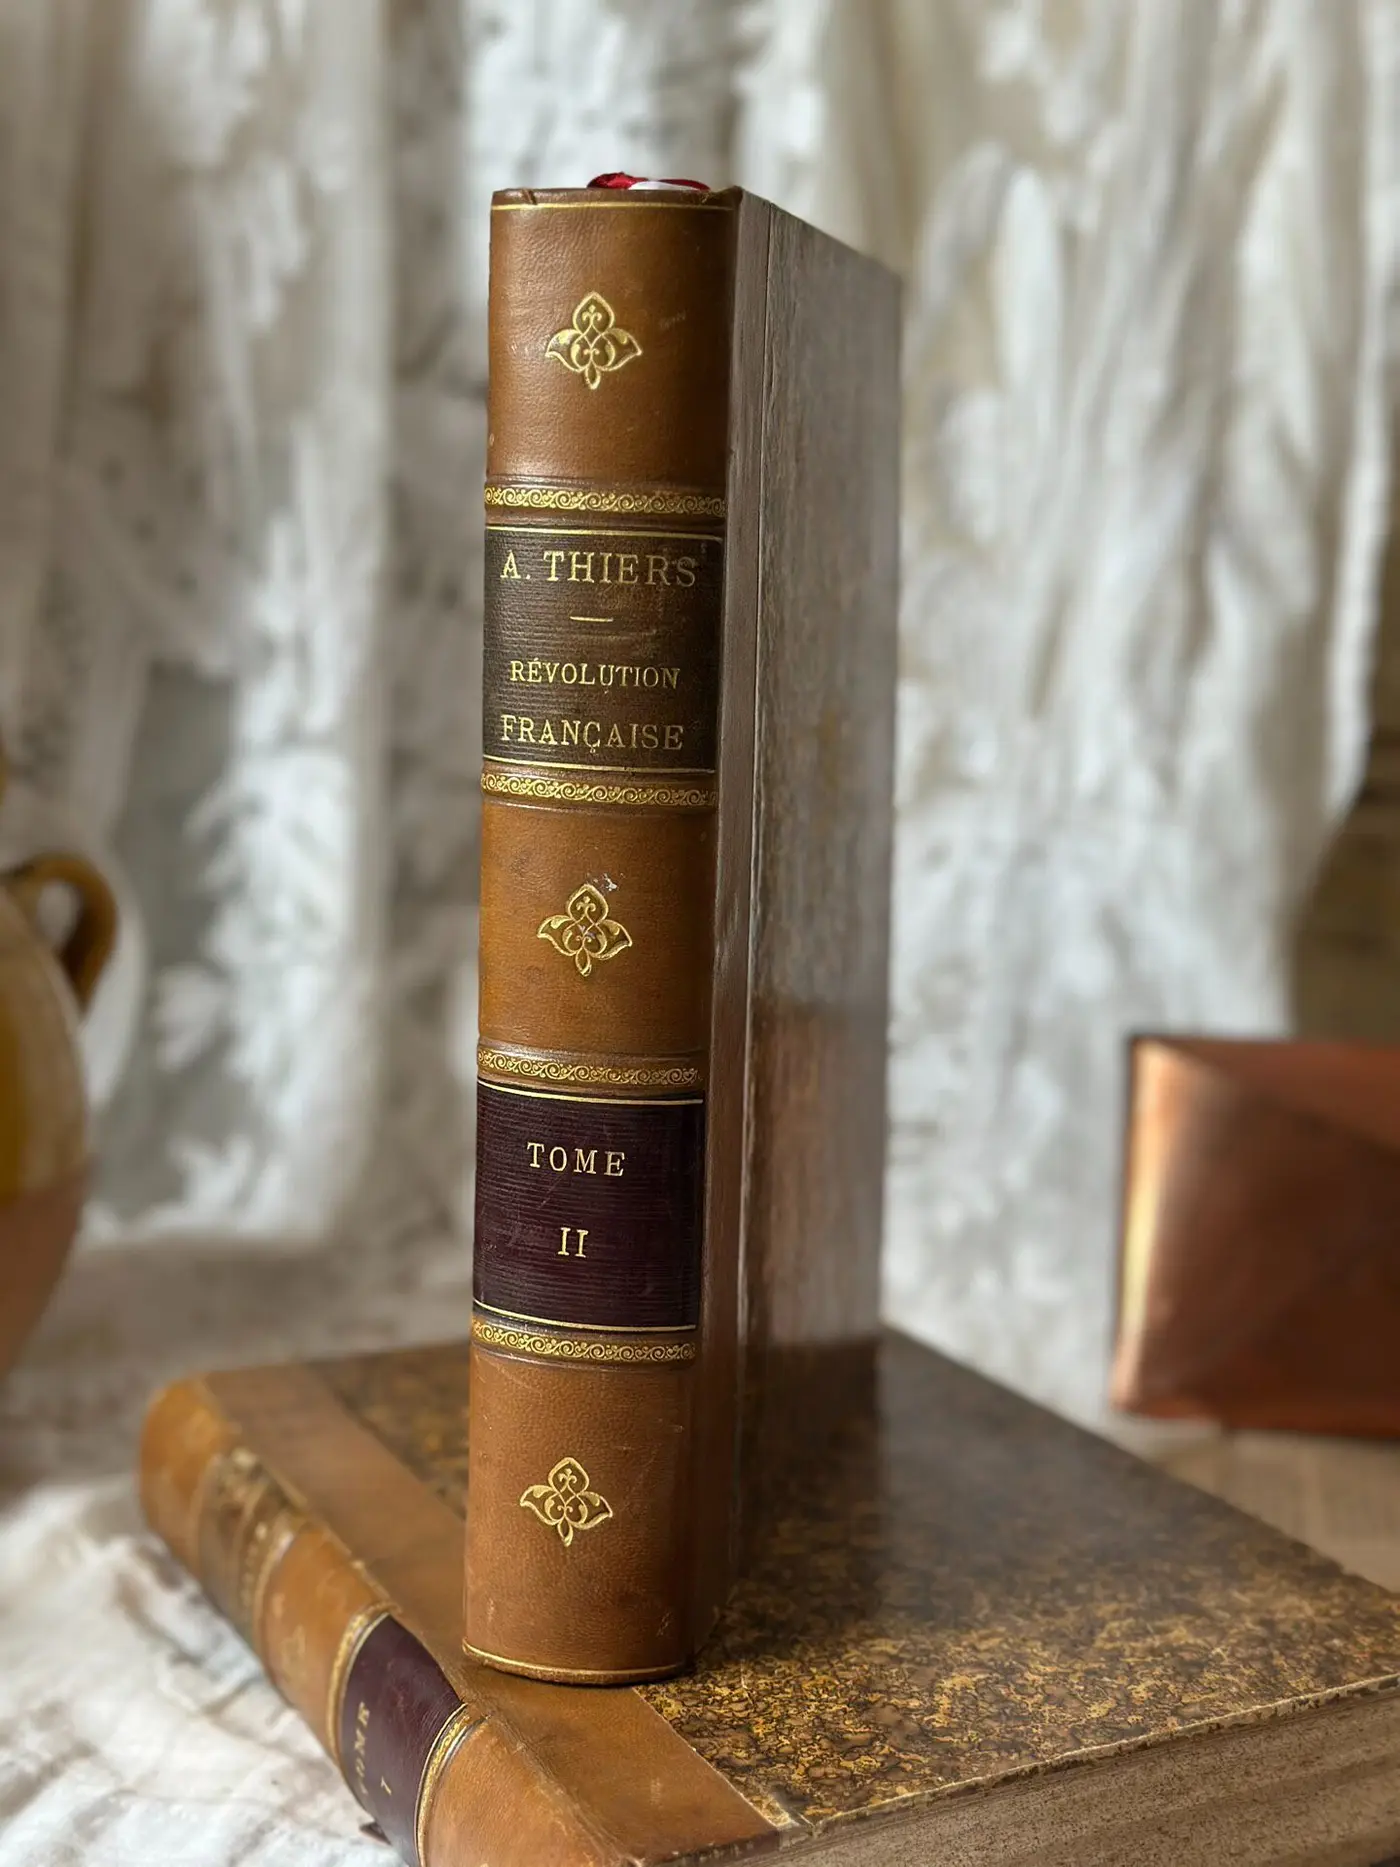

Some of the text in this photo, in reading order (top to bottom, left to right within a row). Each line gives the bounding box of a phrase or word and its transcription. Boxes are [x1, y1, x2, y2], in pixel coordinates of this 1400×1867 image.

[500, 549, 697, 588] A. THIERS
[509, 657, 681, 690] RÉVOLUTION
[500, 714, 684, 753] FRANÇAISE
[527, 1141, 626, 1177] TOME
[557, 1227, 589, 1258] II
